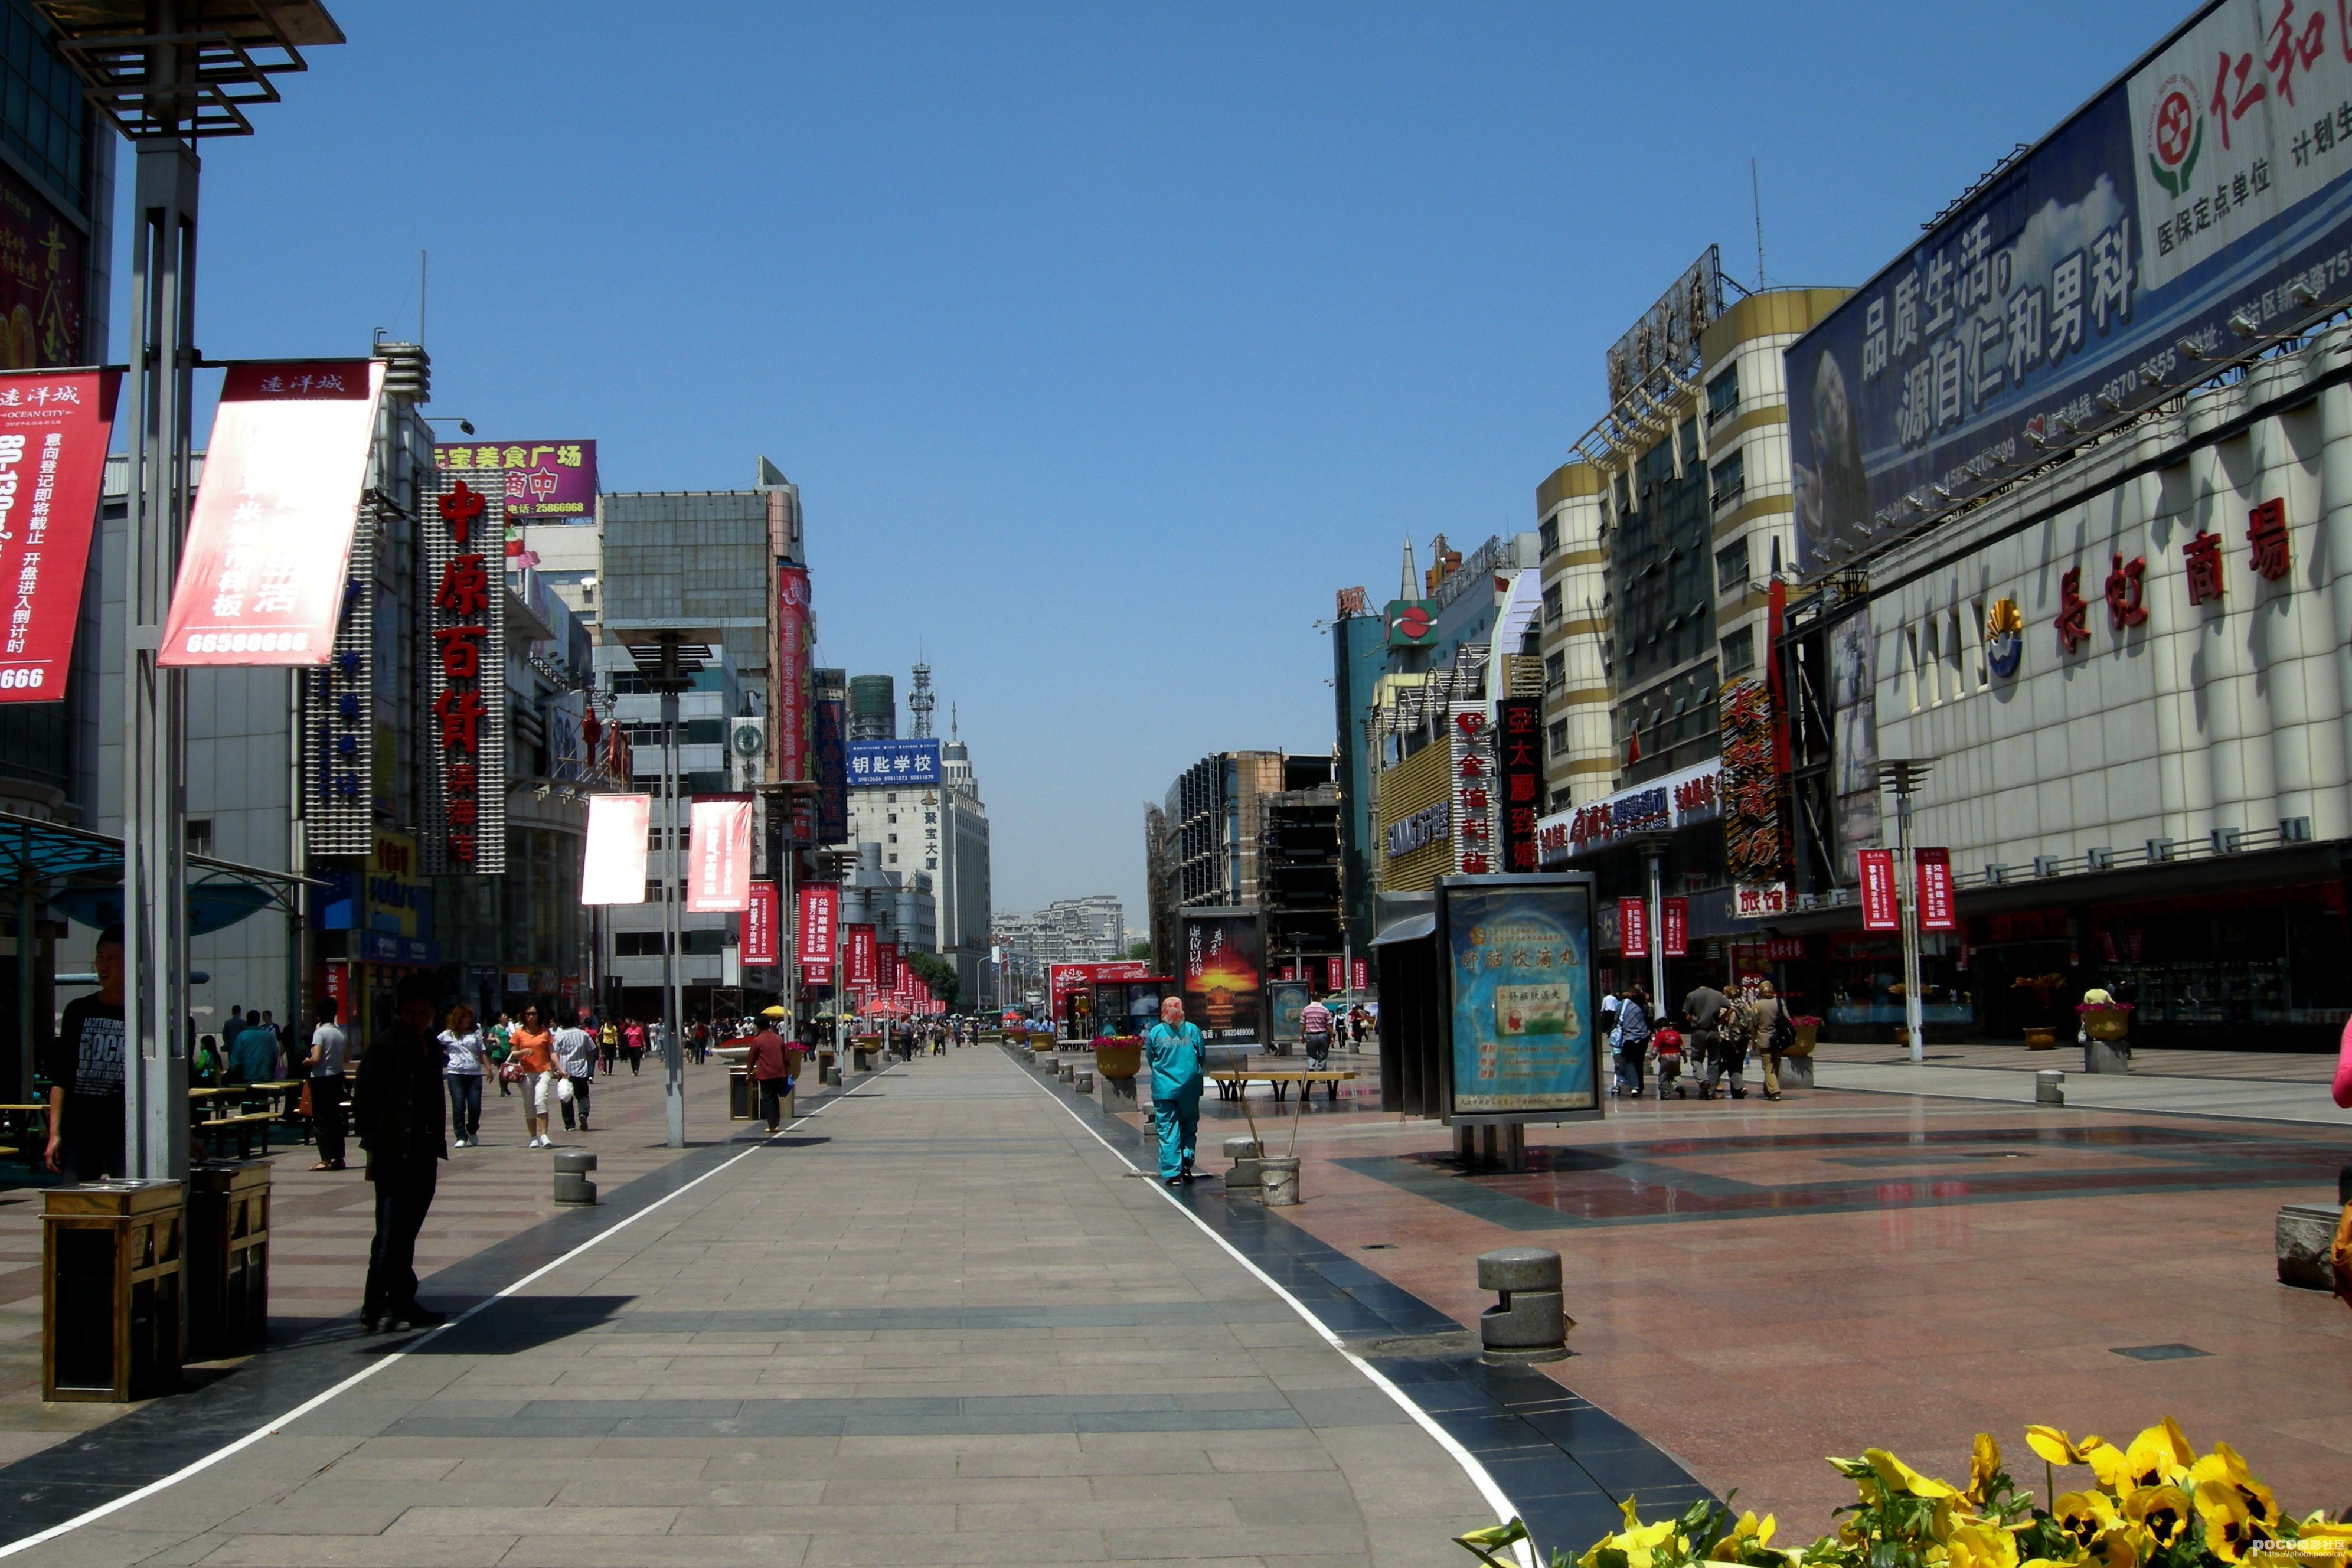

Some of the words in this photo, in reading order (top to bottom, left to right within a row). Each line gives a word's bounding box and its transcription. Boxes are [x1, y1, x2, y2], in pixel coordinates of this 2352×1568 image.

[2210, 0, 2352, 151] 仁和
[2157, 157, 2271, 257] 医保定点单位
[1901, 218, 2134, 445] 源自仁和男科
[26, 433, 62, 544] 意向登记即将截止
[7, 552, 41, 653] 开盘进入倒计时
[186, 632, 308, 653] 66580666
[0, 668, 43, 689] 666
[847, 754, 931, 774] 钥匙学校
[924, 812, 938, 870] 聚宝大厦
[1189, 925, 1203, 976] 虚位以待
[1461, 947, 1579, 971] 舒脑欣滴丸
